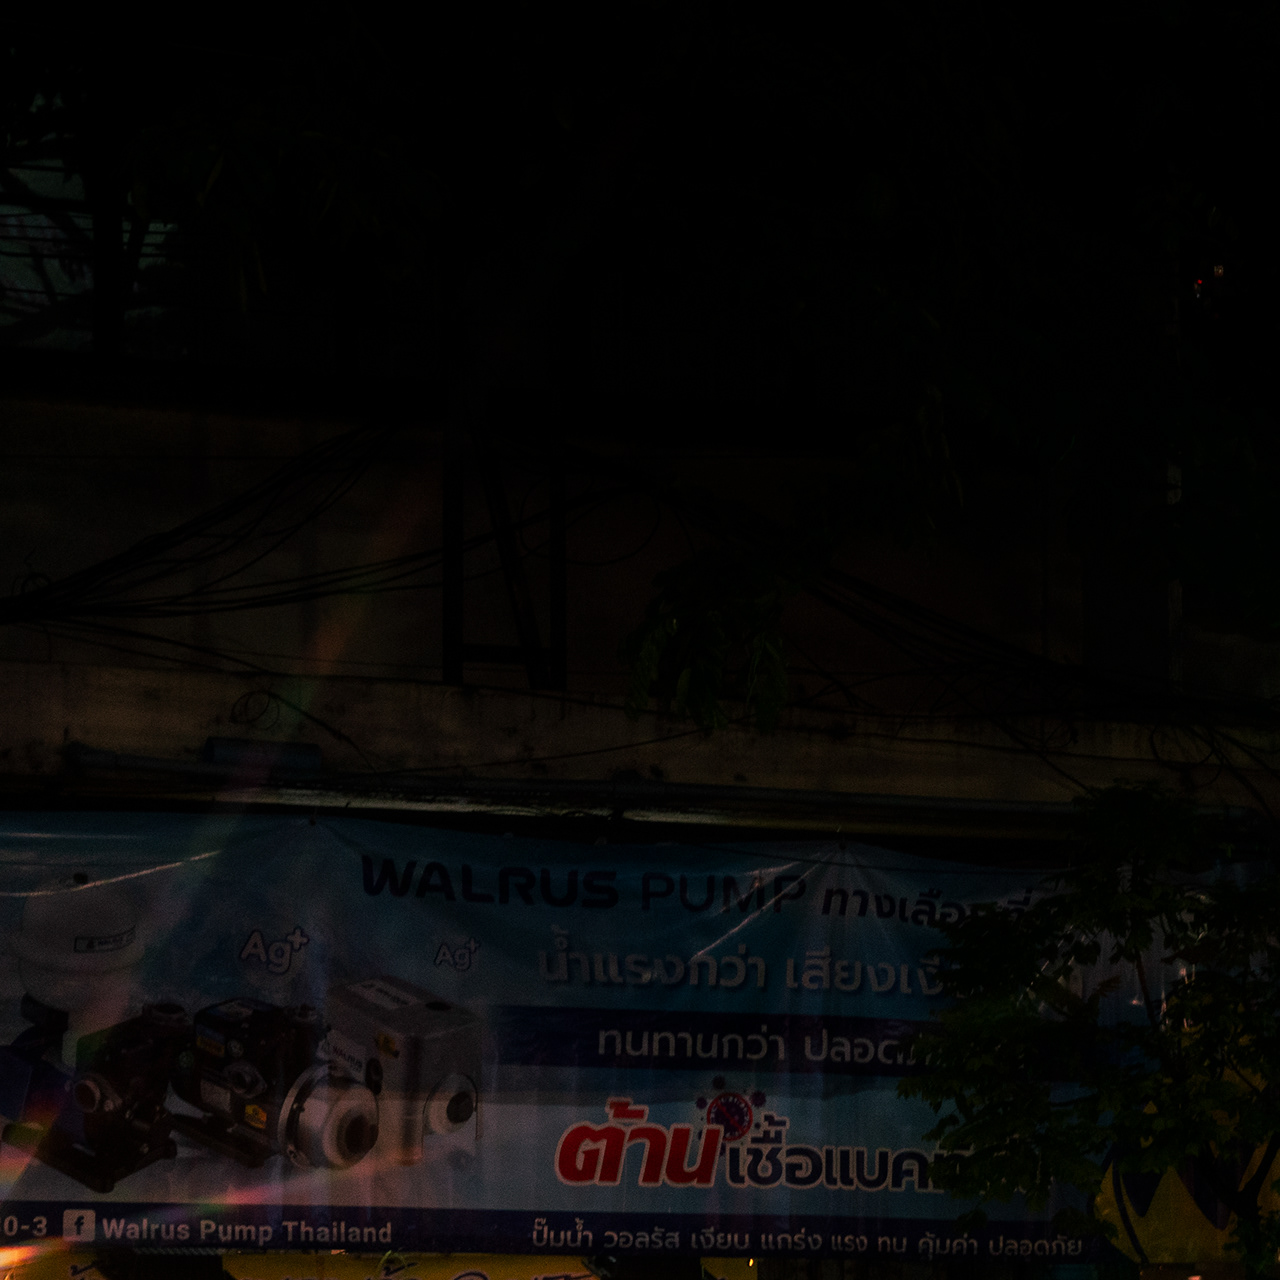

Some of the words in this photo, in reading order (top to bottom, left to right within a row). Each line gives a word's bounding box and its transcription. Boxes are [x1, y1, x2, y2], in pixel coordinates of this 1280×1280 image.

[362, 855, 619, 908] WALRUS
[642, 871, 807, 914] PUMP
[538, 922, 767, 989] น้ำแรงกว่า
[598, 1026, 786, 1061] ทนทานกว่า
[102, 1217, 191, 1242] Walrus
[200, 1219, 273, 1246] Pump
[282, 1220, 393, 1244] Thailand
[532, 1217, 594, 1248] ปั๊มน้ำ
[603, 1227, 680, 1250] วอลรัส
[691, 1228, 751, 1251] เงียบ
[760, 1229, 823, 1253] แกร่ง
[830, 1232, 868, 1253] แรง
[876, 1235, 908, 1254] ทน
[918, 1231, 979, 1257] คุ้มค่า
[989, 1234, 1084, 1257] ปลอดภัย
